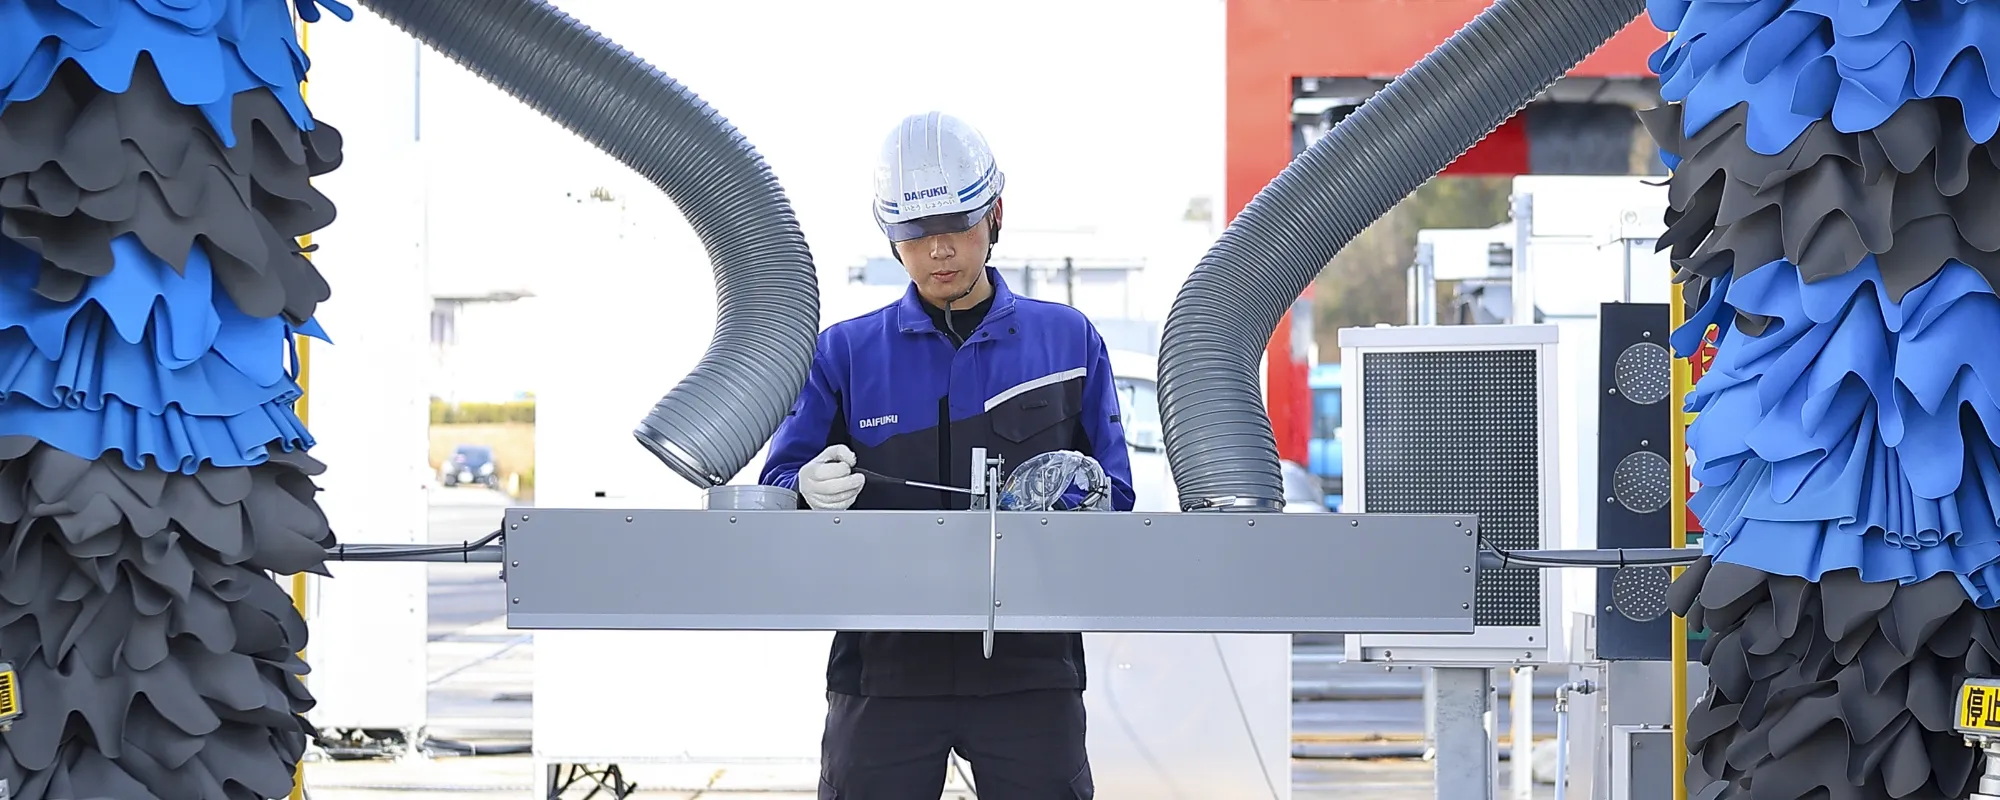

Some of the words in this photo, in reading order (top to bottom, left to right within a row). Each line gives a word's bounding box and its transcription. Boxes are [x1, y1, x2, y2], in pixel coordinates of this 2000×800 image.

[904, 186, 948, 201] DAIFUKU
[859, 414, 898, 429] DAIFUKU
[1966, 687, 2000, 727] 停止
